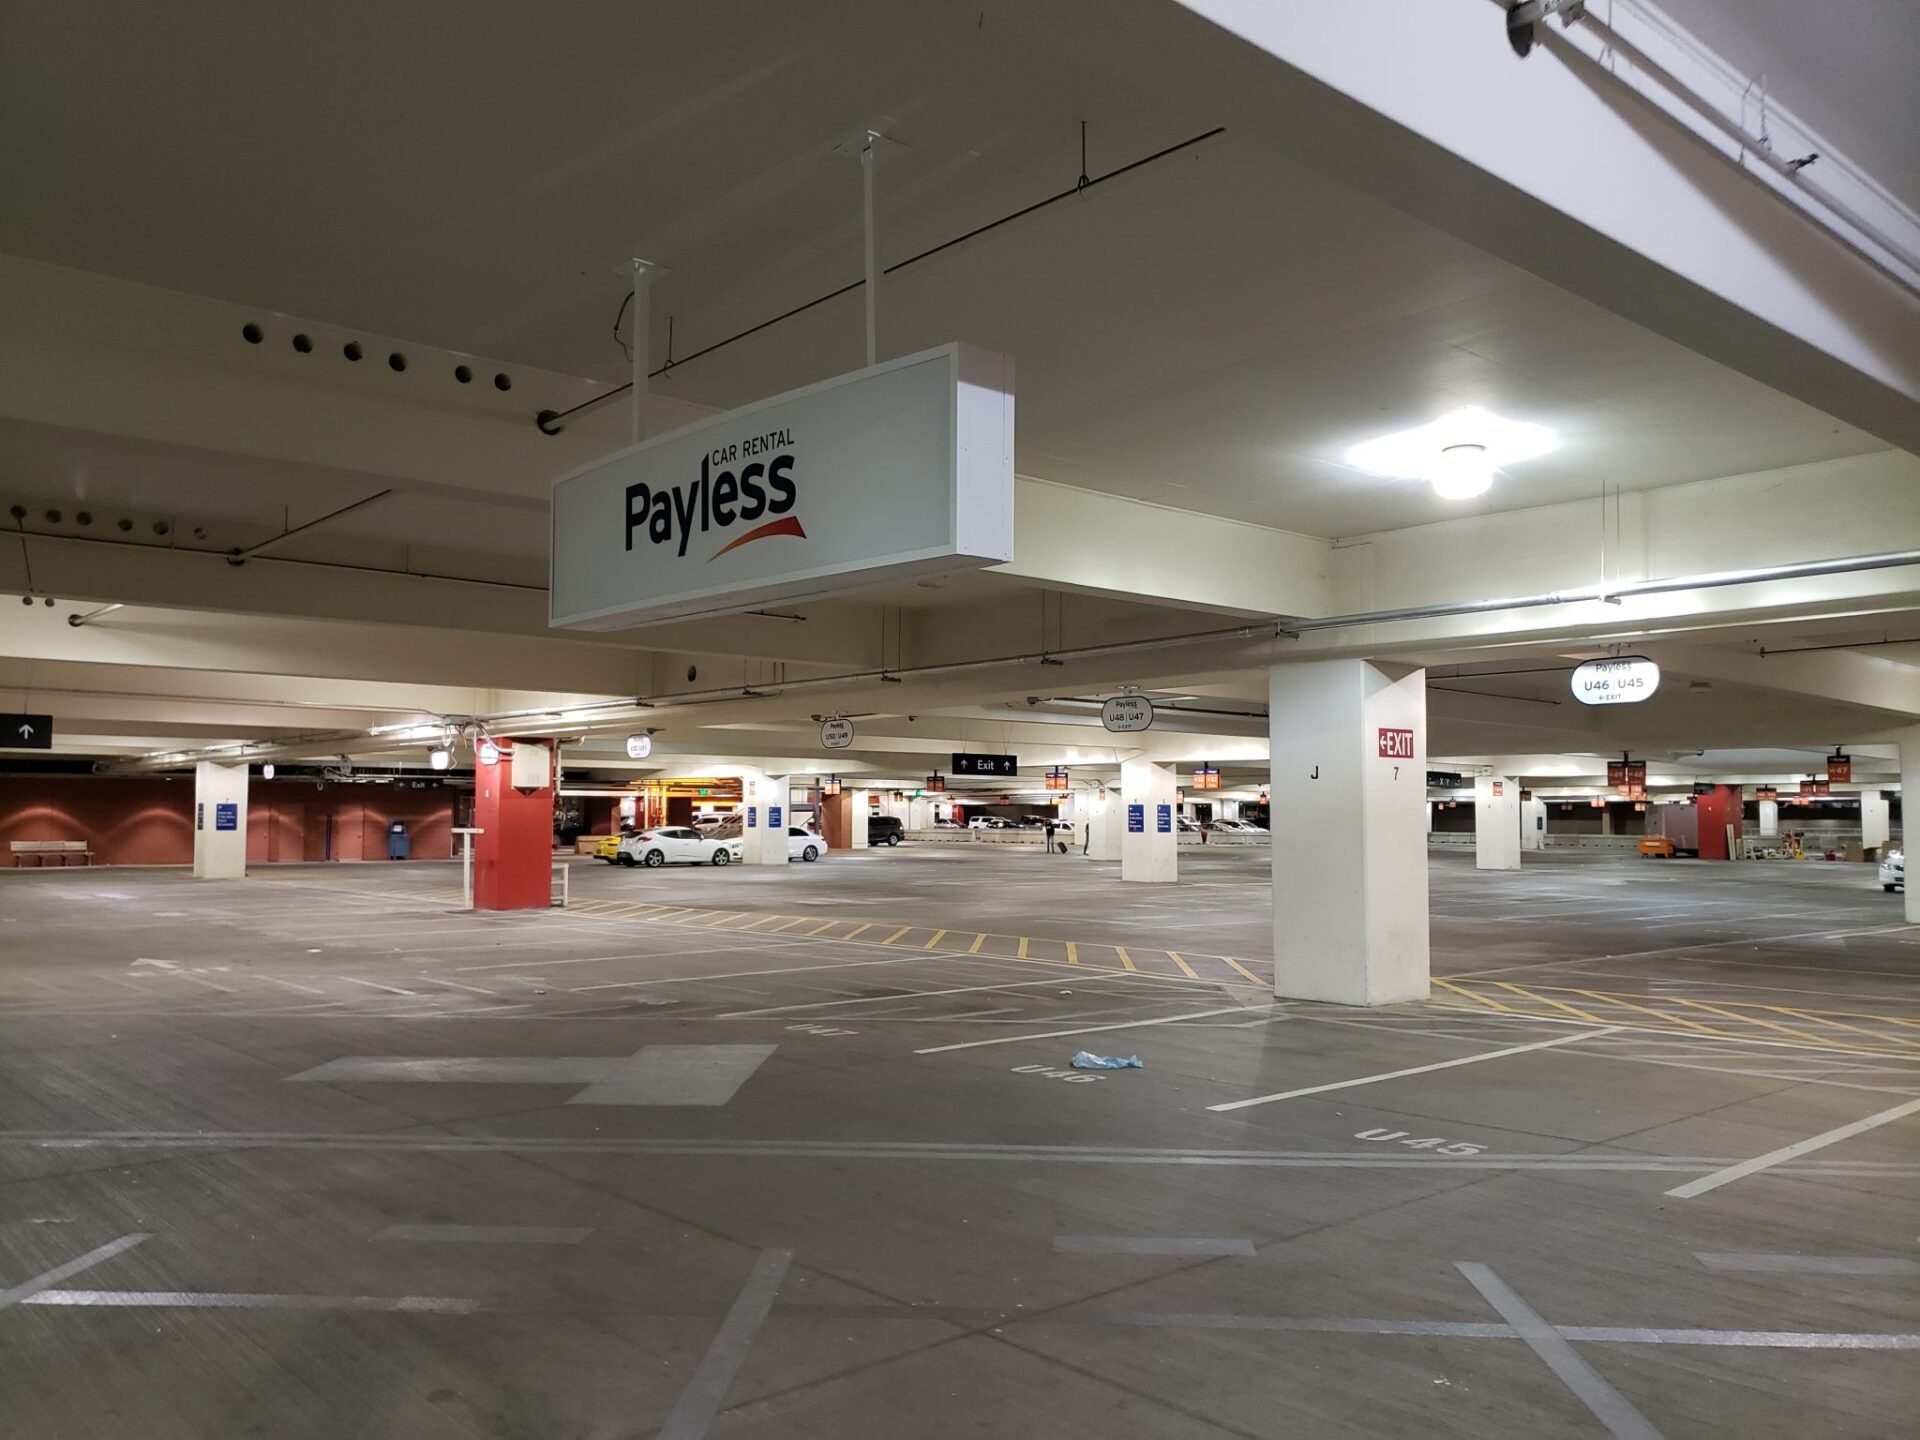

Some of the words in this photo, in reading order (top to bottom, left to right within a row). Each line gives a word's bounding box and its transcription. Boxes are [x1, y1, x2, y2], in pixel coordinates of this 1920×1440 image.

[712, 444, 737, 466] CAR
[743, 428, 795, 458] RENTAL
[626, 453, 797, 557] Payless
[1595, 660, 1632, 674] Payless
[1584, 680, 1609, 691] U46
[1618, 677, 1644, 689] U45
[1605, 693, 1621, 701] EXIT
[1115, 700, 1138, 709] Payless
[1109, 713, 1124, 722] U48
[1128, 712, 1144, 721] U47
[1386, 731, 1412, 756] EXIT
[977, 759, 995, 771] Exit
[1310, 765, 1319, 780] J
[1393, 766, 1399, 781] 7
[411, 781, 425, 789] Exit
[784, 1023, 860, 1037] U47
[1011, 1064, 1107, 1083] U46
[1353, 1128, 1489, 1156] U45
